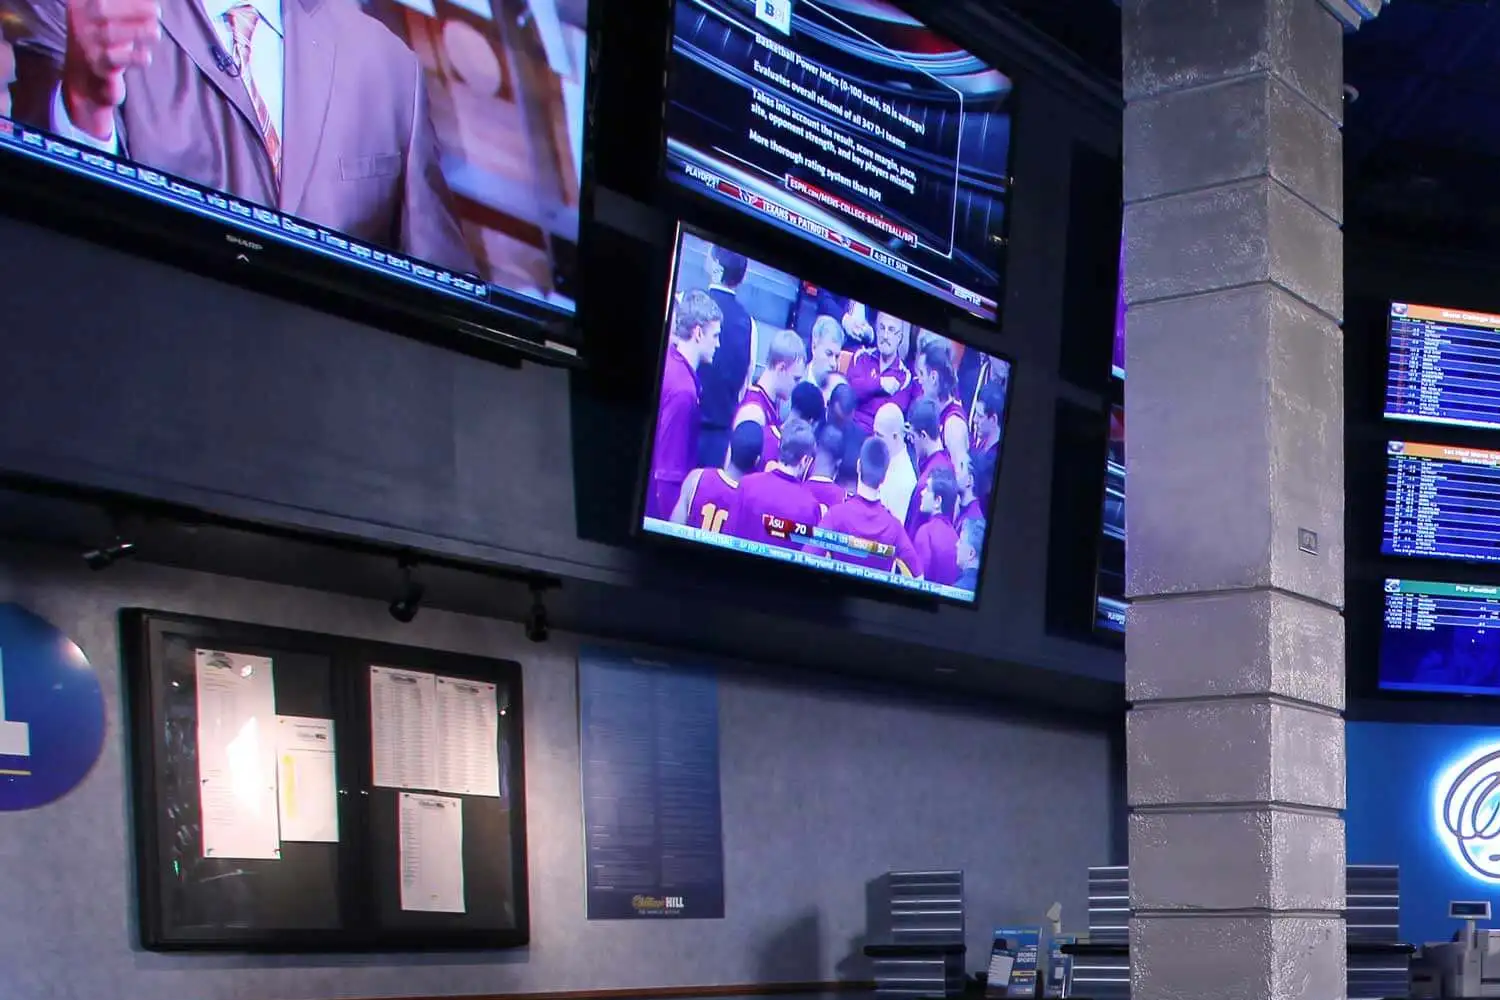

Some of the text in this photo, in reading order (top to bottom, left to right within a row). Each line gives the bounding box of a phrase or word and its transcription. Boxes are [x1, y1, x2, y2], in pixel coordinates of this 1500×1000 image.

[754, 60, 790, 88] Evaluates
[792, 81, 816, 102] overall
[844, 108, 853, 120] of
[853, 111, 862, 124] all
[862, 118, 874, 132] 347
[886, 130, 906, 149] teams
[755, 34, 796, 62] Basketball
[796, 56, 818, 75] Power
[819, 68, 839, 88] Index
[840, 78, 862, 100] (0-100
[863, 90, 882, 111] scale,
[898, 113, 925, 135] average)
[751, 102, 915, 195] site, opponent strength, and key players missing
[752, 87, 917, 182] Takes into account the result, score margin, pace,
[750, 128, 882, 202] More thorough rating system than RPI
[46, 139, 80, 159] your
[82, 151, 115, 171] vote
[116, 162, 136, 178] on
[206, 194, 228, 210] via
[229, 199, 252, 218] the
[253, 207, 281, 228] NBA
[282, 216, 318, 240] Game
[318, 228, 348, 250] Time
[350, 242, 372, 259] app
[373, 250, 386, 262] or
[386, 252, 411, 272] text
[412, 263, 436, 278] your
[436, 271, 474, 292] all-star
[226, 234, 263, 250] SHARP
[763, 201, 789, 221] TEXANS
[798, 217, 829, 240] PATRIOTS
[888, 257, 896, 268] ET
[896, 260, 908, 273] SUN
[769, 514, 785, 530] ASU
[794, 522, 806, 535] 70
[876, 544, 890, 555] 57
[1470, 586, 1497, 594] Football
[665, 896, 684, 908] HILL
